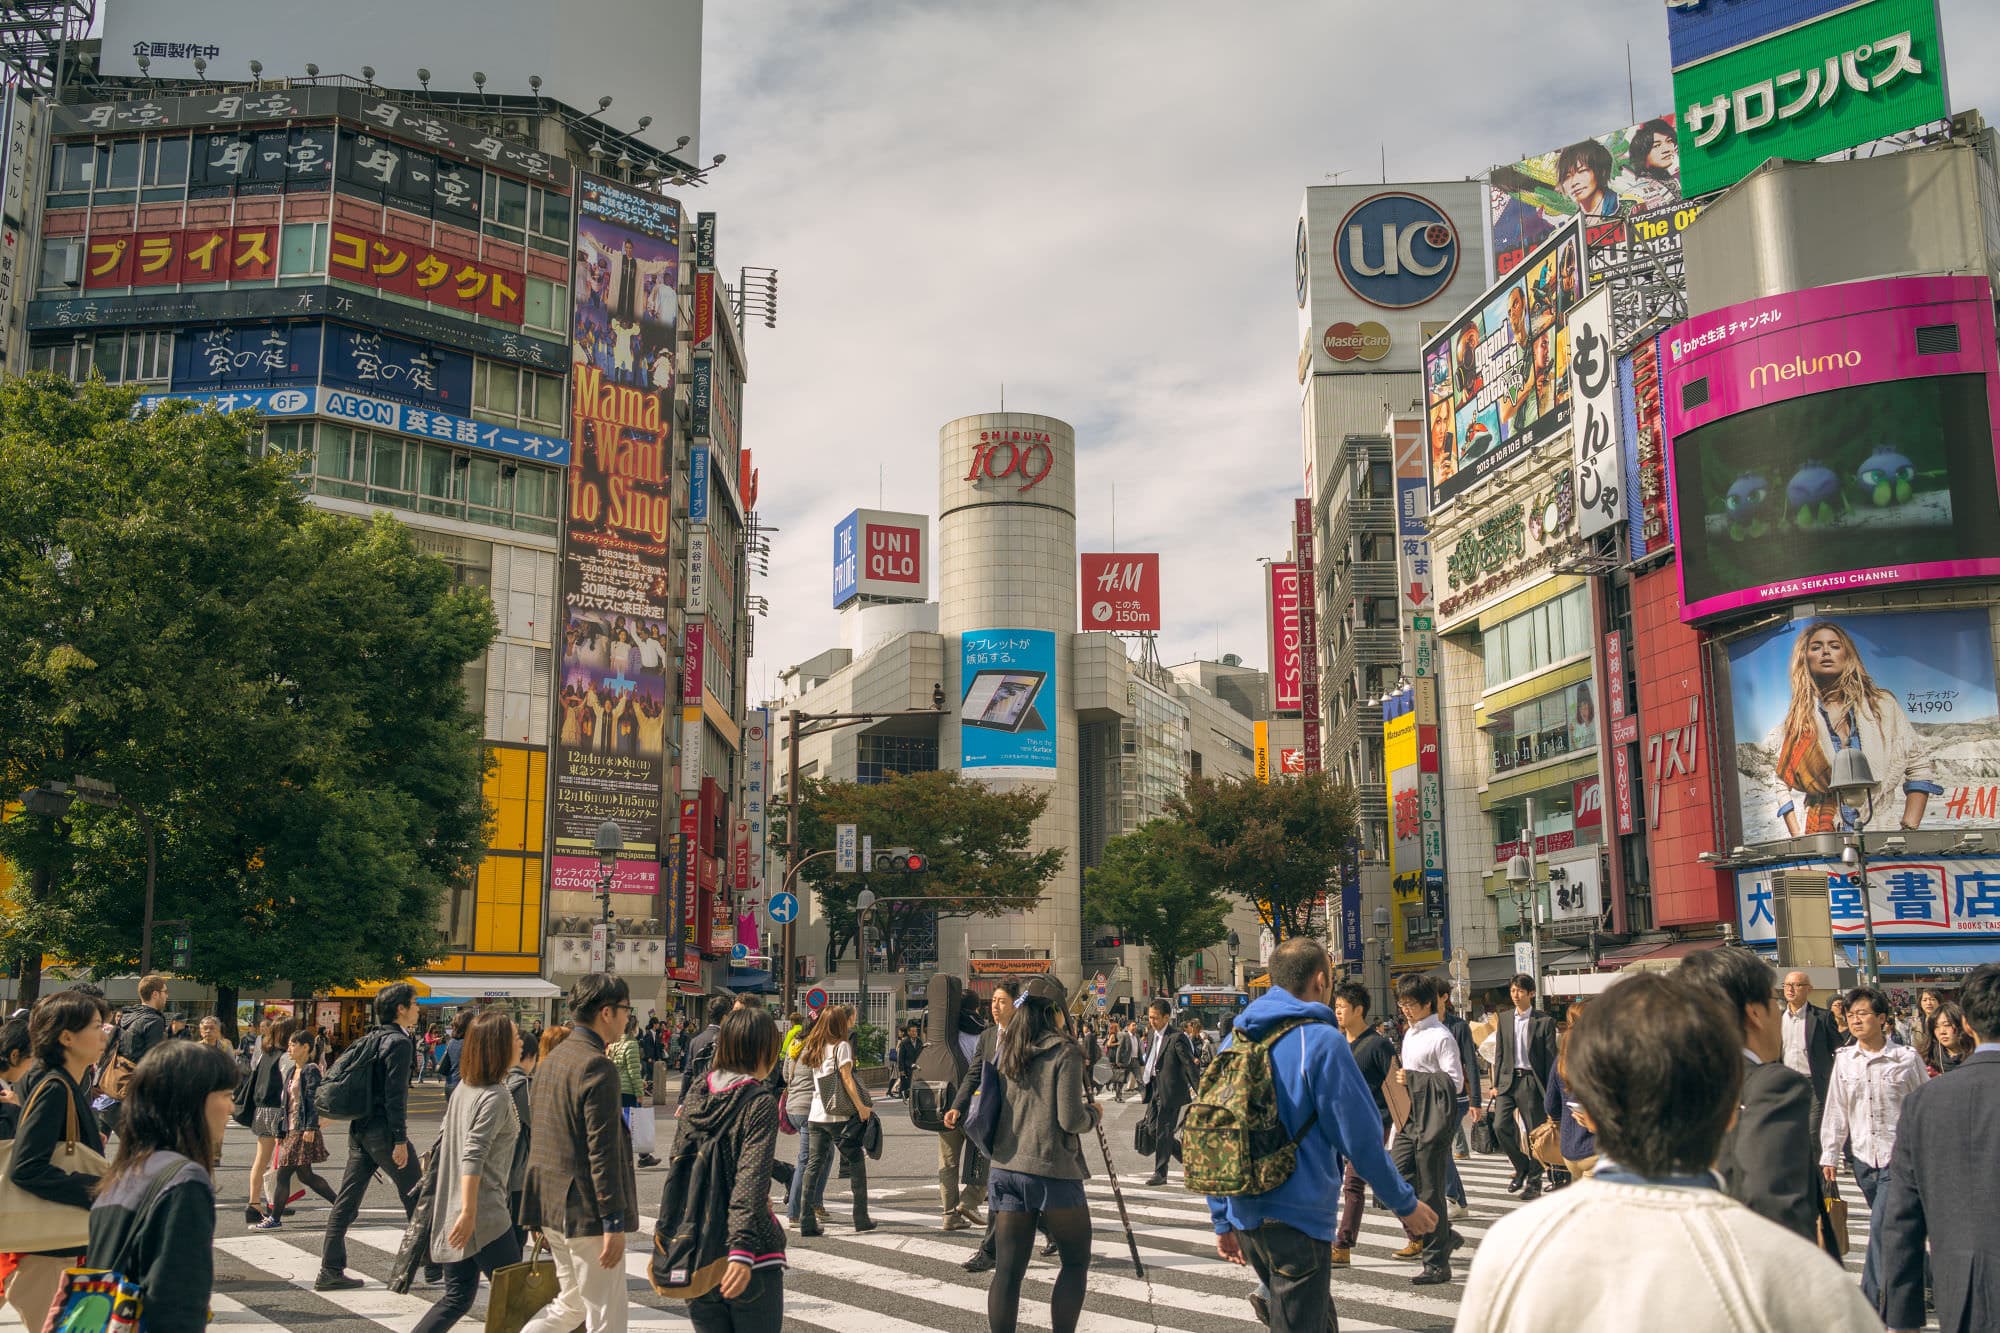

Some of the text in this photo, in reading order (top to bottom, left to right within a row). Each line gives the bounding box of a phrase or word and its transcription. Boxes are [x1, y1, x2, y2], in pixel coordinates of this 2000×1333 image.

[133, 41, 220, 60] 企画製作中
[1684, 30, 1922, 148] サロンパス
[211, 136, 227, 147] 9F
[358, 135, 375, 148] 9F
[91, 232, 271, 276] プライス
[332, 232, 517, 306] コンタクト
[336, 296, 353, 312] 7F
[1325, 335, 1390, 348] MasterCard
[1683, 309, 1781, 355] わかさ生活 チャンネル
[278, 395, 299, 409] 6F
[327, 393, 394, 425] AEON
[575, 364, 669, 438] Mama,
[406, 409, 564, 458] 英会話イーオン
[1573, 322, 1619, 520] もんじゃ
[596, 421, 665, 483] Want
[980, 431, 1051, 443] SHIBUYA
[963, 441, 1054, 493] 109
[572, 471, 669, 543] to Sing
[839, 525, 852, 560] THE
[872, 531, 910, 553] UNI
[691, 541, 702, 606] 渋谷駅前ビル
[834, 555, 855, 596] PRIME
[872, 554, 914, 576] QLO
[1097, 562, 1143, 592] H&M
[1760, 569, 1900, 597] WAKASA SEIKATSU CHANNEL
[567, 592, 664, 618] クリスマスに来日決定!
[1115, 601, 1141, 610] この先
[1115, 611, 1150, 622] 150m
[688, 624, 703, 632] 5F
[1276, 567, 1300, 706] Essential
[967, 639, 1030, 652] タブレットが
[967, 652, 1016, 665] 嫉妬する。
[1907, 690, 1959, 702] カーディガン
[1907, 701, 1953, 714] ¥1,990
[1493, 735, 1565, 769] Euphoria
[1578, 783, 1600, 818] JTB
[1945, 786, 1998, 820] H&M
[1748, 871, 2000, 927] 大堂書店
